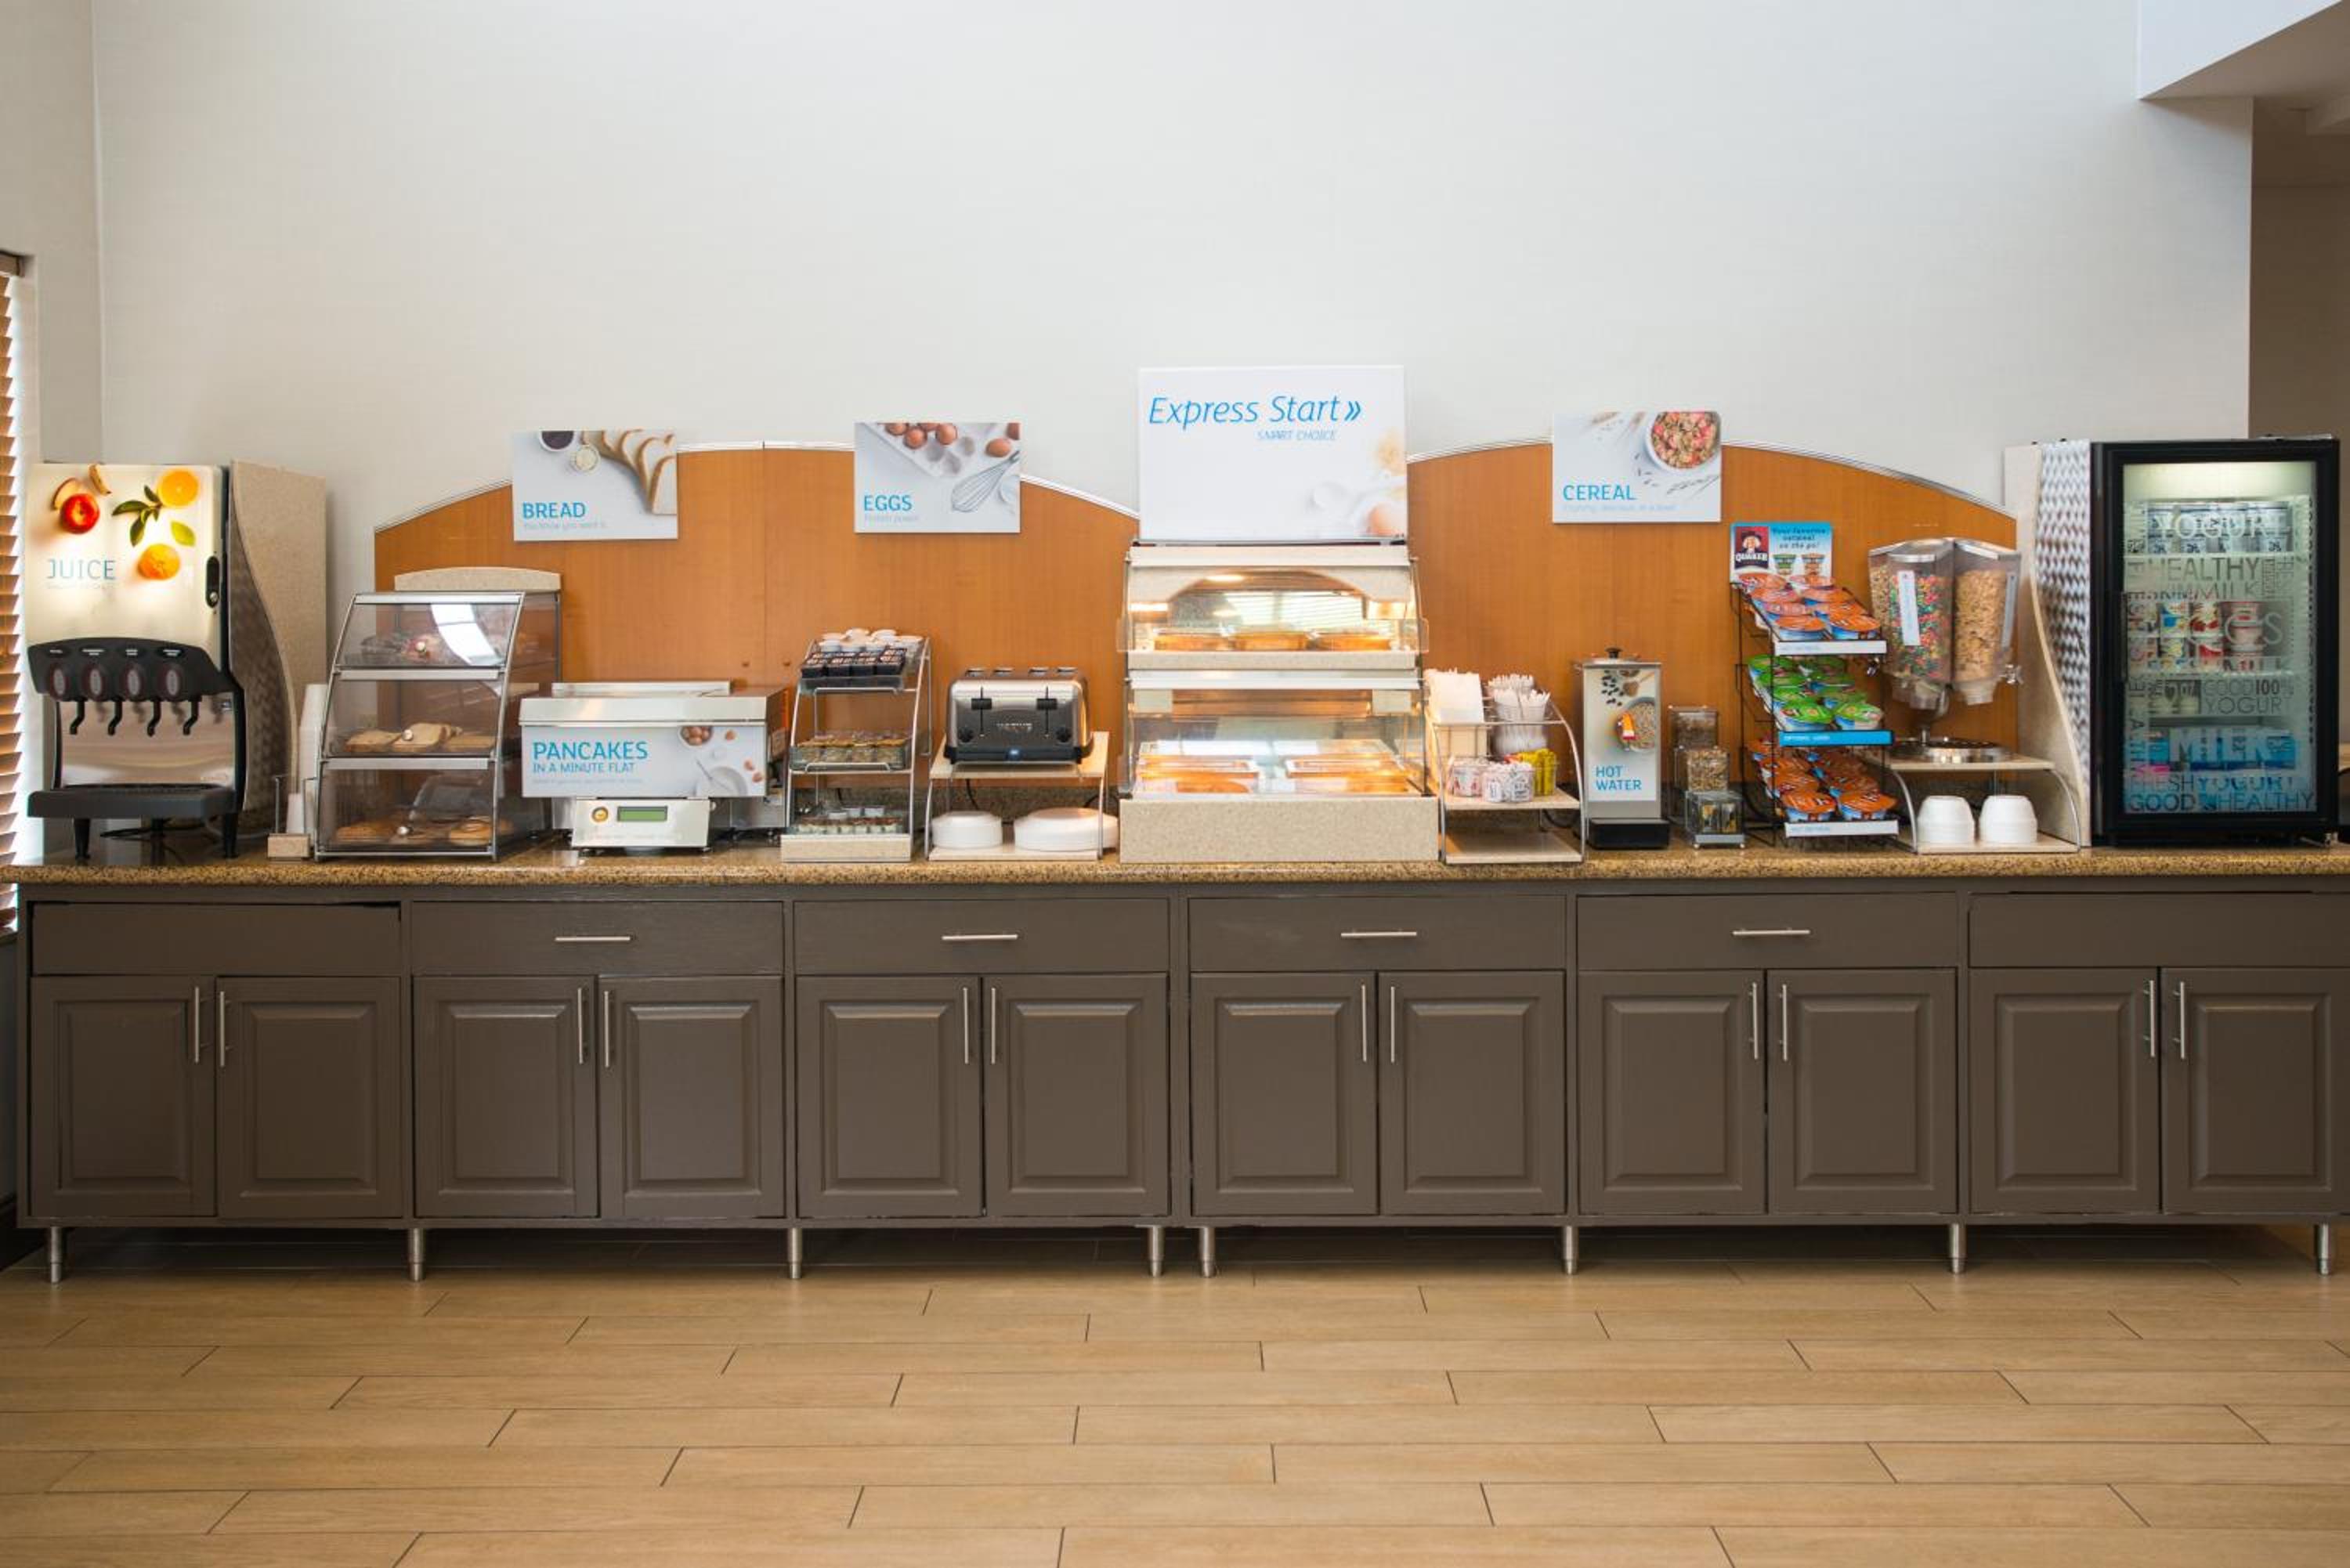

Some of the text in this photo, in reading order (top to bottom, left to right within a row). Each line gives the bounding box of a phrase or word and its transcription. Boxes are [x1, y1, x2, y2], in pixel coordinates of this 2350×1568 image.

[1149, 396, 1259, 430] Express
[1258, 431, 1337, 440] SMART CHOICE
[1563, 485, 1638, 500] CEREAL
[522, 501, 586, 518] BREAD
[864, 494, 913, 511] EGGS
[2153, 511, 2291, 538] YOGURT
[1735, 551, 1768, 562] QUAKER
[47, 558, 115, 580] JUICE
[2148, 557, 2259, 581] HEALTHY
[533, 741, 649, 760] PANCAKES
[533, 762, 635, 773] IN A MINUTE FLAT
[1596, 765, 1623, 778] HOT
[1596, 779, 1642, 790] WATER
[2128, 793, 2196, 811] GOOD
[2218, 792, 2316, 811] HEALTHY
